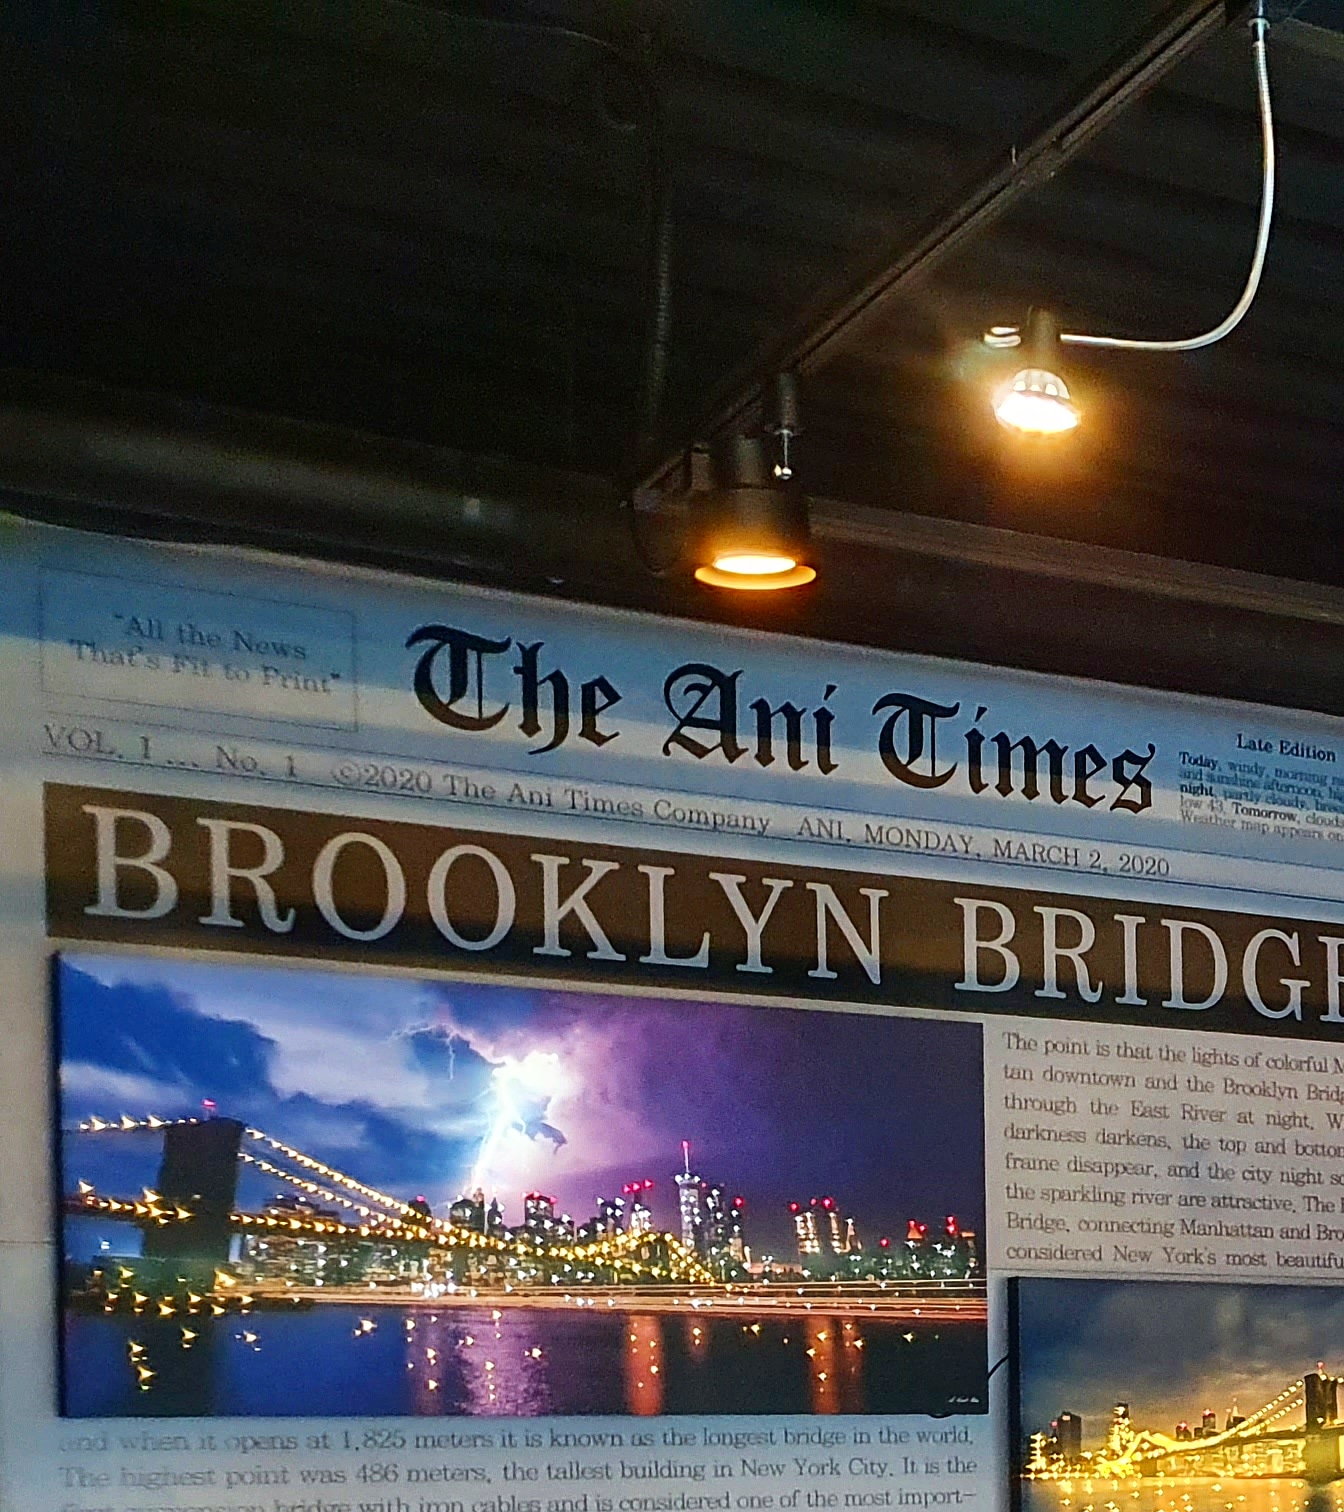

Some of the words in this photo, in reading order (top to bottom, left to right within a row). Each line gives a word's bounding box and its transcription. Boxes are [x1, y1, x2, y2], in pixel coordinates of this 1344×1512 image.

[178, 622, 222, 648] the
[233, 630, 306, 660] News
[225, 663, 250, 682] to
[405, 622, 623, 755] The
[661, 662, 840, 775] Ani
[871, 691, 1157, 815] Times
[44, 723, 124, 759] VOL.
[216, 745, 266, 775] No.
[286, 755, 297, 777] 1
[1237, 733, 1273, 751] Late
[1279, 740, 1336, 762] Edition
[444, 773, 496, 800] The
[509, 783, 553, 807] Ani
[565, 787, 643, 817] Times
[653, 799, 770, 837] Company
[994, 839, 1081, 868] MARCH
[1119, 854, 1171, 877] 2020
[82, 804, 890, 986] BROOKLYN
[1003, 1032, 1038, 1052] The
[1044, 1039, 1090, 1060] point
[1096, 1042, 1111, 1057] is
[1116, 1041, 1154, 1060] that
[1159, 1044, 1186, 1063] the
[1192, 1047, 1239, 1068] lights
[1244, 1051, 1262, 1067] of
[1265, 1052, 1328, 1072] colorful
[1004, 1064, 1033, 1081] tan
[1042, 1064, 1136, 1088] downtown
[1145, 1072, 1177, 1090] and
[1187, 1075, 1214, 1092] the
[1224, 1076, 1298, 1101] Brooklyn
[1006, 1243, 1102, 1262] considered
[1114, 1243, 1152, 1263] New
[1162, 1245, 1216, 1266] York's
[1226, 1250, 1267, 1267] most
[226, 1464, 289, 1490] point
[301, 1466, 345, 1485] was
[355, 1462, 399, 1484] 486
[503, 1462, 538, 1481] the
[546, 1461, 612, 1480] tallest
[620, 1457, 705, 1483] building
[713, 1459, 732, 1477] in
[741, 1459, 785, 1478] New
[798, 1457, 841, 1476] York
[902, 1455, 918, 1475] It
[925, 1455, 939, 1474] is
[946, 1455, 977, 1474] the
